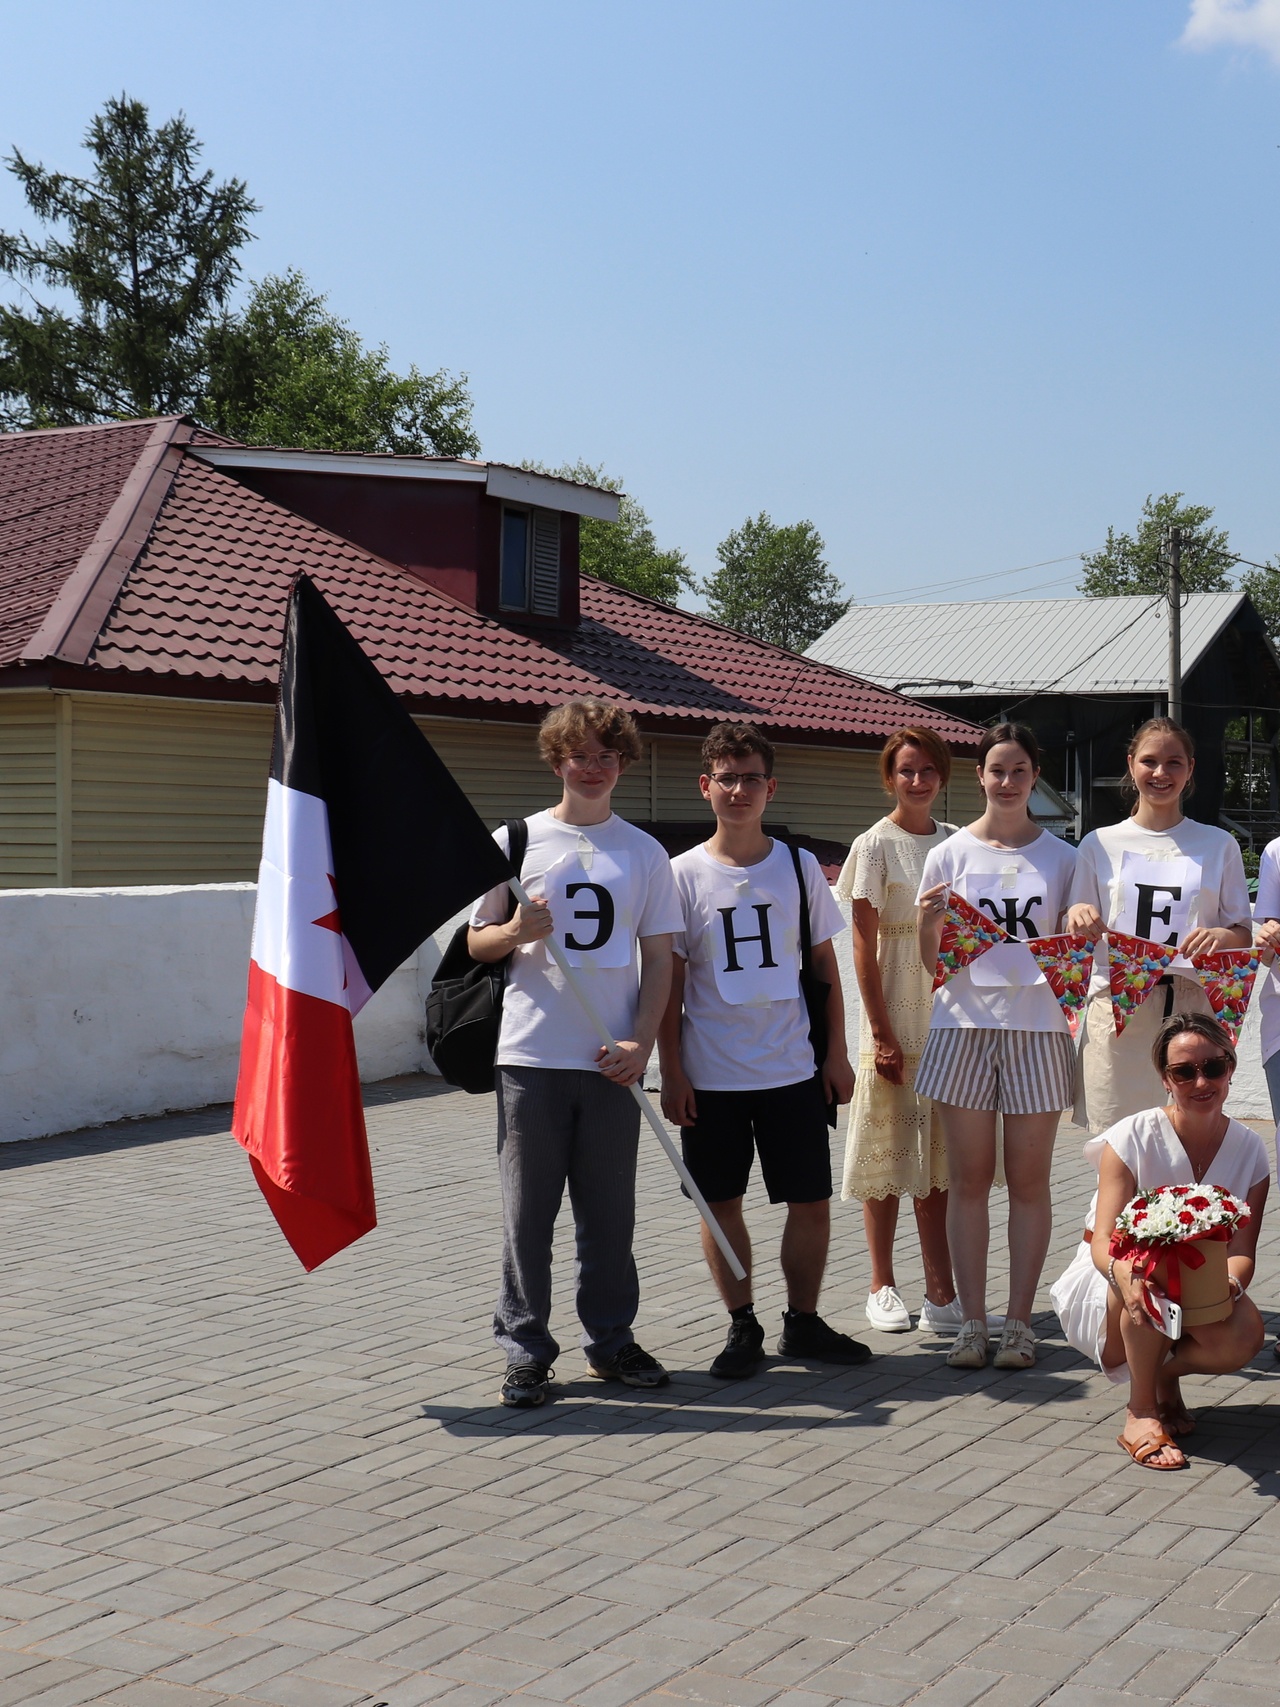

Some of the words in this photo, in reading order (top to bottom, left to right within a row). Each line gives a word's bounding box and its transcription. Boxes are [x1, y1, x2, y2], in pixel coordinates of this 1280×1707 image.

[564, 882, 615, 952] Э
[716, 903, 779, 973] Н
[978, 895, 1043, 944] Ж
[1134, 883, 1182, 948] Е
